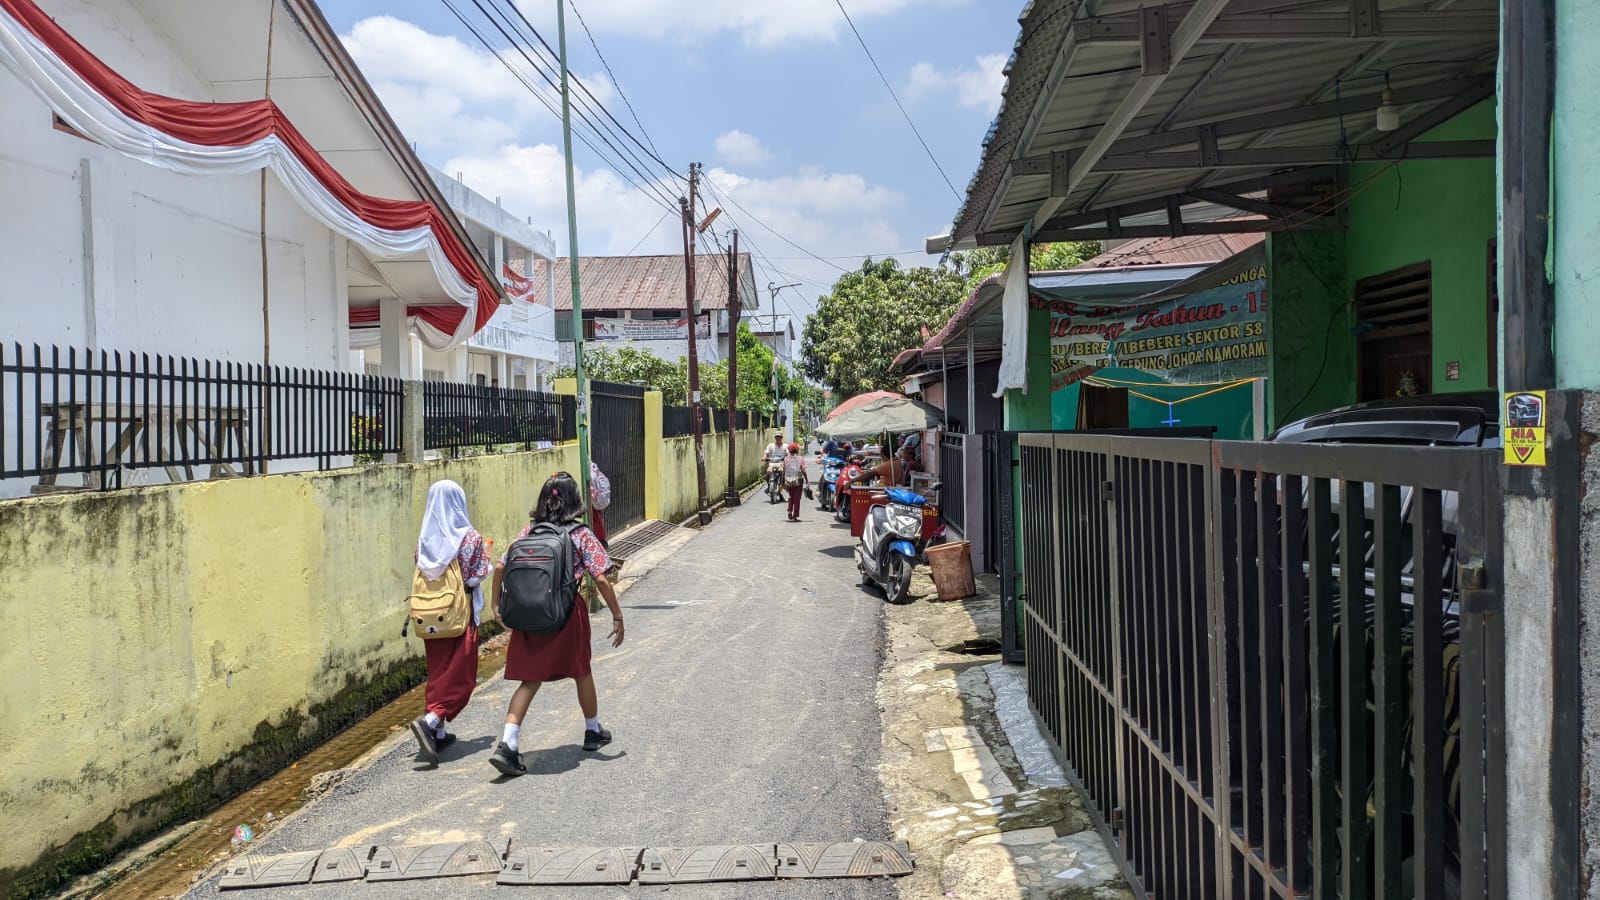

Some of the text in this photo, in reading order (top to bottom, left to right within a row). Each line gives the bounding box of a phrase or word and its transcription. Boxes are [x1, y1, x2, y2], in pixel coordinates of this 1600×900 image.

[1132, 303, 1226, 331] Tahun
[1186, 325, 1240, 346] SEKTOR
[1244, 322, 1263, 337] 58
[1167, 350, 1202, 370] JOHOR
[1205, 341, 1267, 363] NAMORAM
[1511, 428, 1537, 440] NIA
